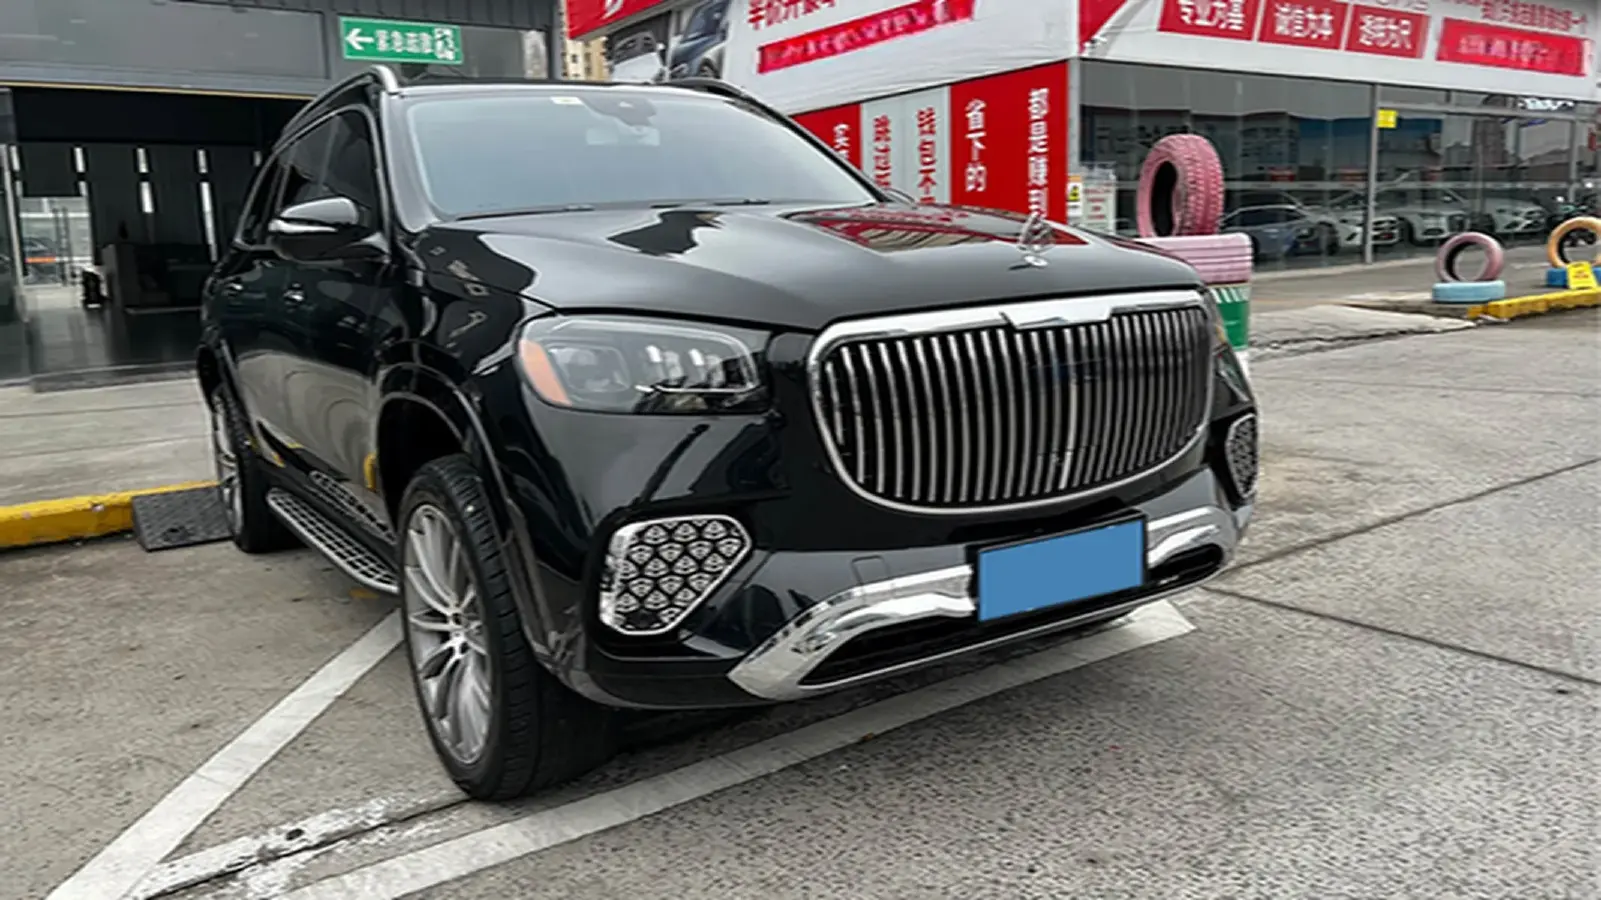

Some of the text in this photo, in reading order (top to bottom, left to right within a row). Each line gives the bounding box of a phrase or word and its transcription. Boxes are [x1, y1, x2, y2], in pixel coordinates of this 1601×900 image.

[917, 107, 937, 203] 钱包不
[965, 99, 987, 192] 省下的
